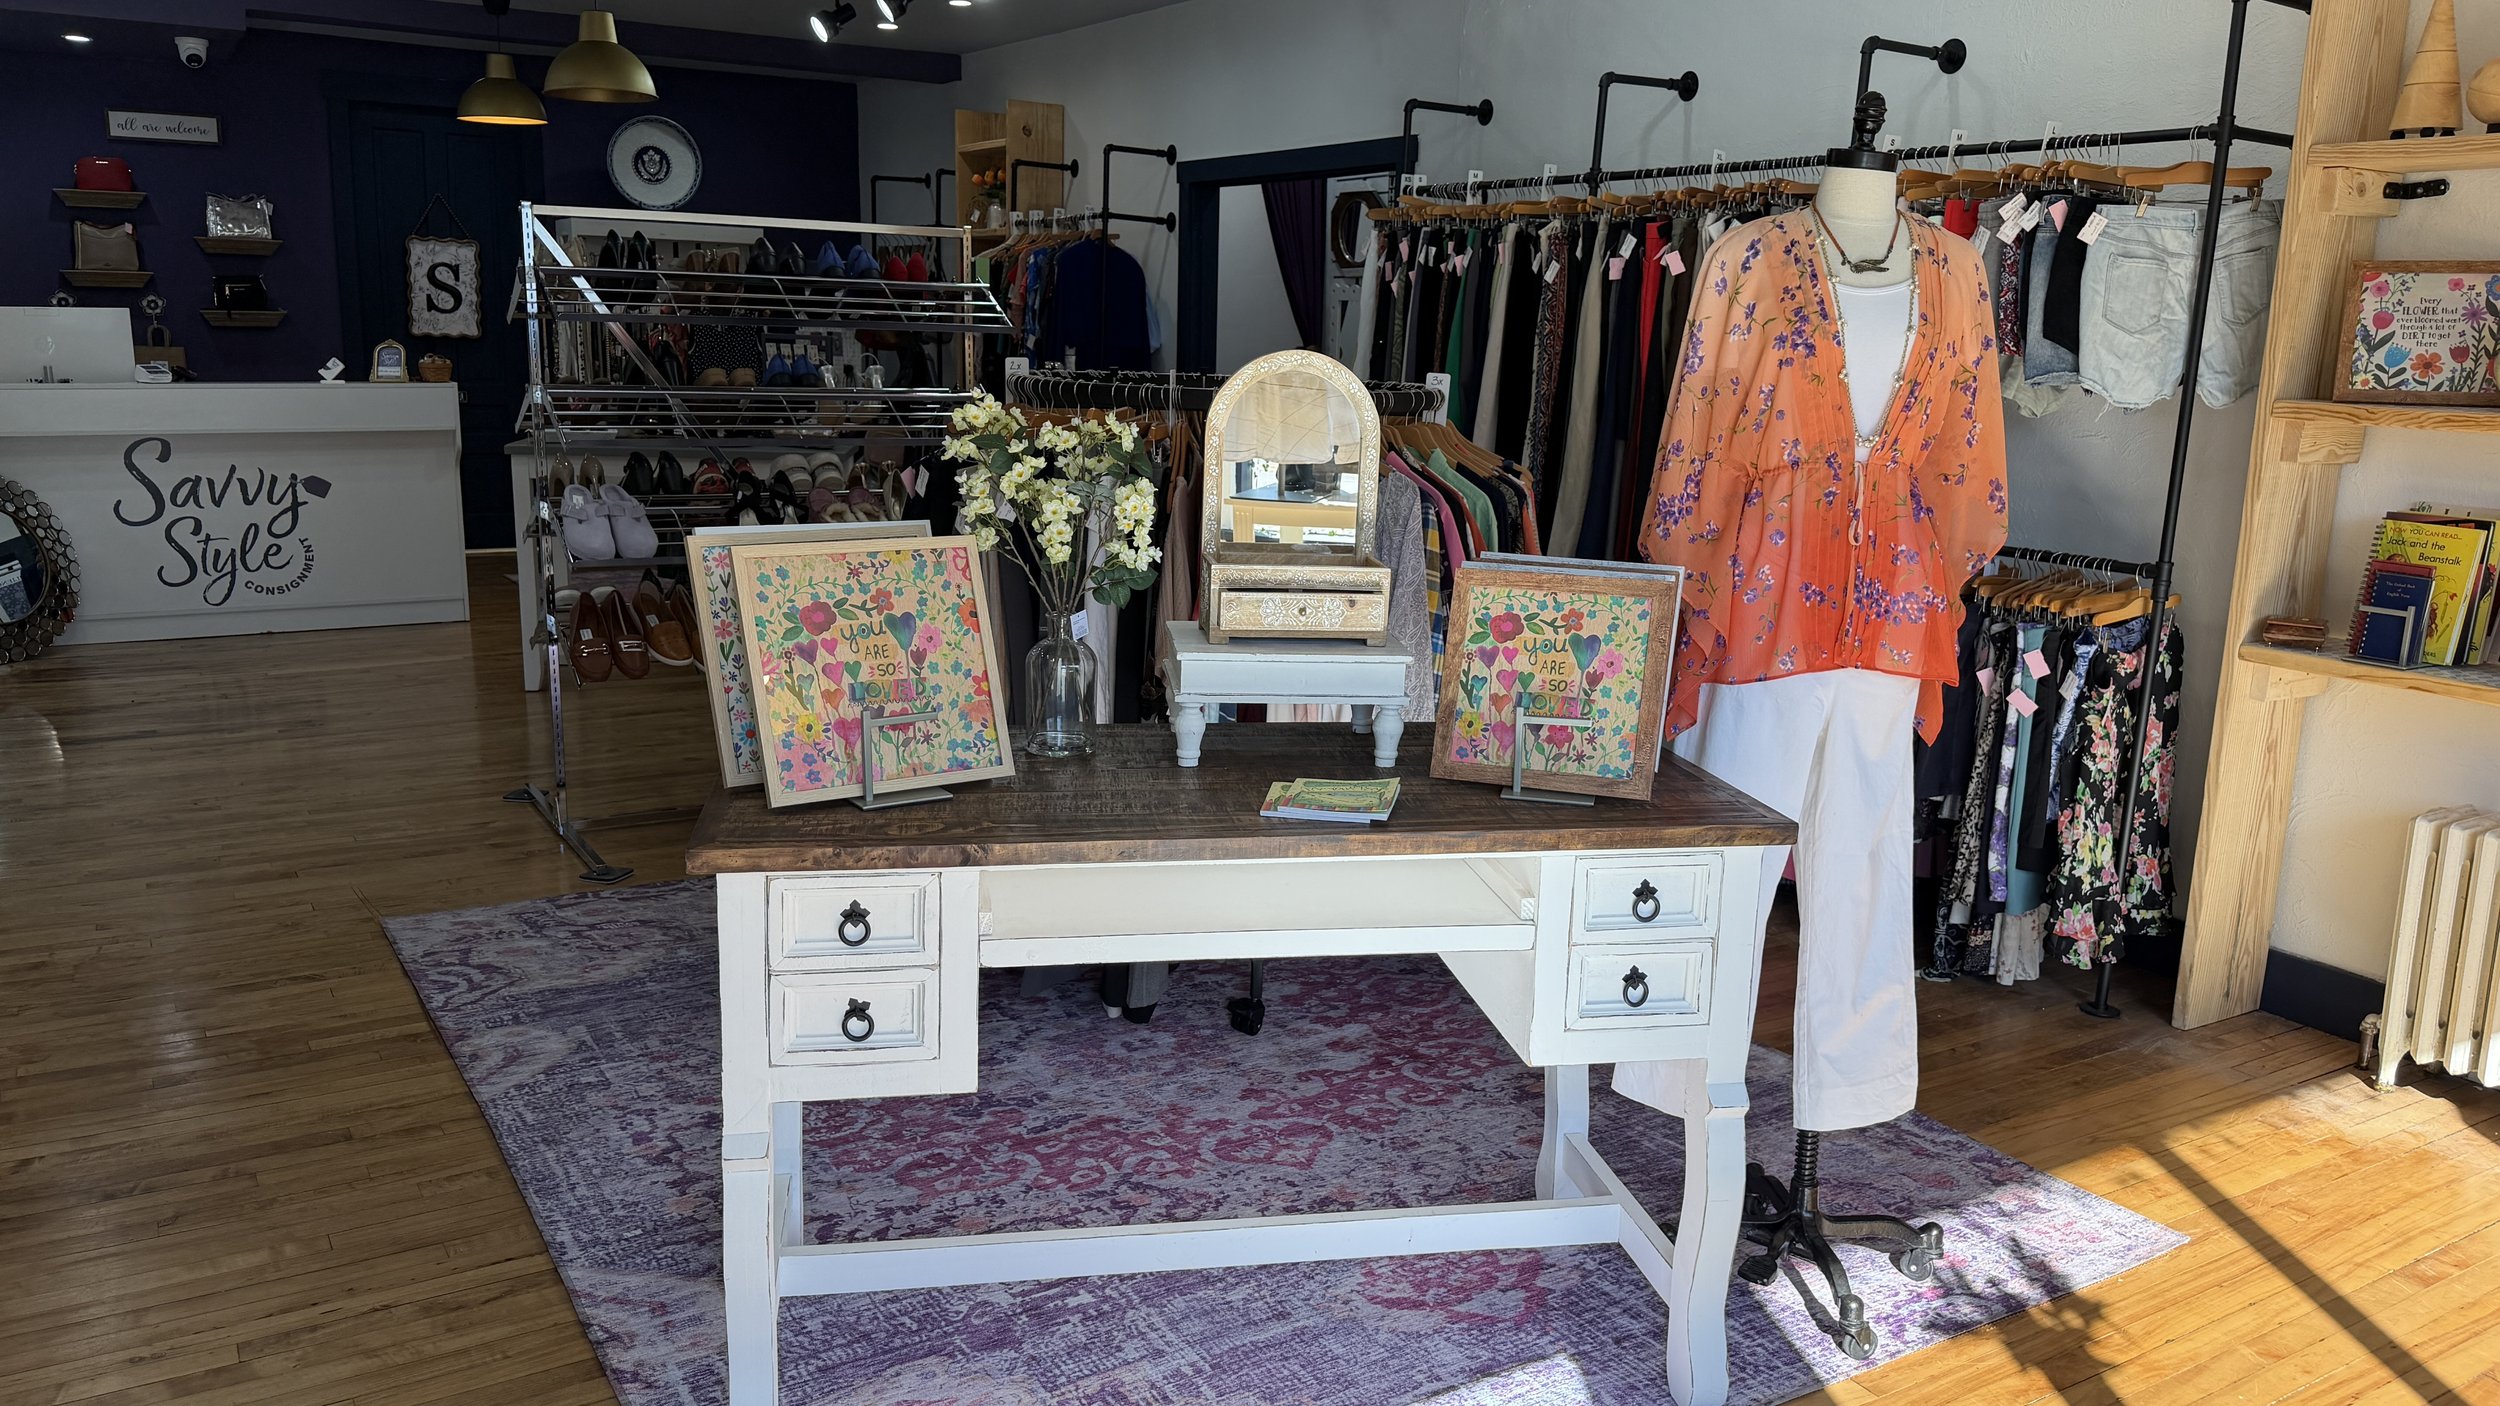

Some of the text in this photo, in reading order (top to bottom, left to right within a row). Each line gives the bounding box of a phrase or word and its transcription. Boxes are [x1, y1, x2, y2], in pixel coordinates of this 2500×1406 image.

[117, 117, 210, 135] all are welcome
[1957, 133, 1963, 141] M
[426, 262, 462, 314] S
[2420, 297, 2442, 306] Every
[2402, 306, 2458, 315] FLOWER that
[2400, 323, 2427, 332] through
[2414, 316, 2444, 324] bloomed
[2401, 331, 2426, 340] DIRT
[2437, 332, 2451, 341] get
[2416, 340, 2438, 348] there
[113, 437, 308, 538] Savvy
[2389, 526, 2408, 534] NOW
[2409, 528, 2424, 536] YOU
[2424, 530, 2440, 538] CAN
[2386, 536, 2446, 551] Jack and the
[157, 516, 294, 606] Style
[245, 537, 315, 596] CONSIGNMENT
[2418, 552, 2462, 566] Beanstalk
[841, 620, 887, 654] you
[864, 643, 890, 661] ARE
[1523, 637, 1569, 666] you
[876, 662, 896, 677] SO
[1540, 659, 1567, 676] ARE
[848, 678, 927, 701] LOVED
[1548, 678, 1568, 692] SO
